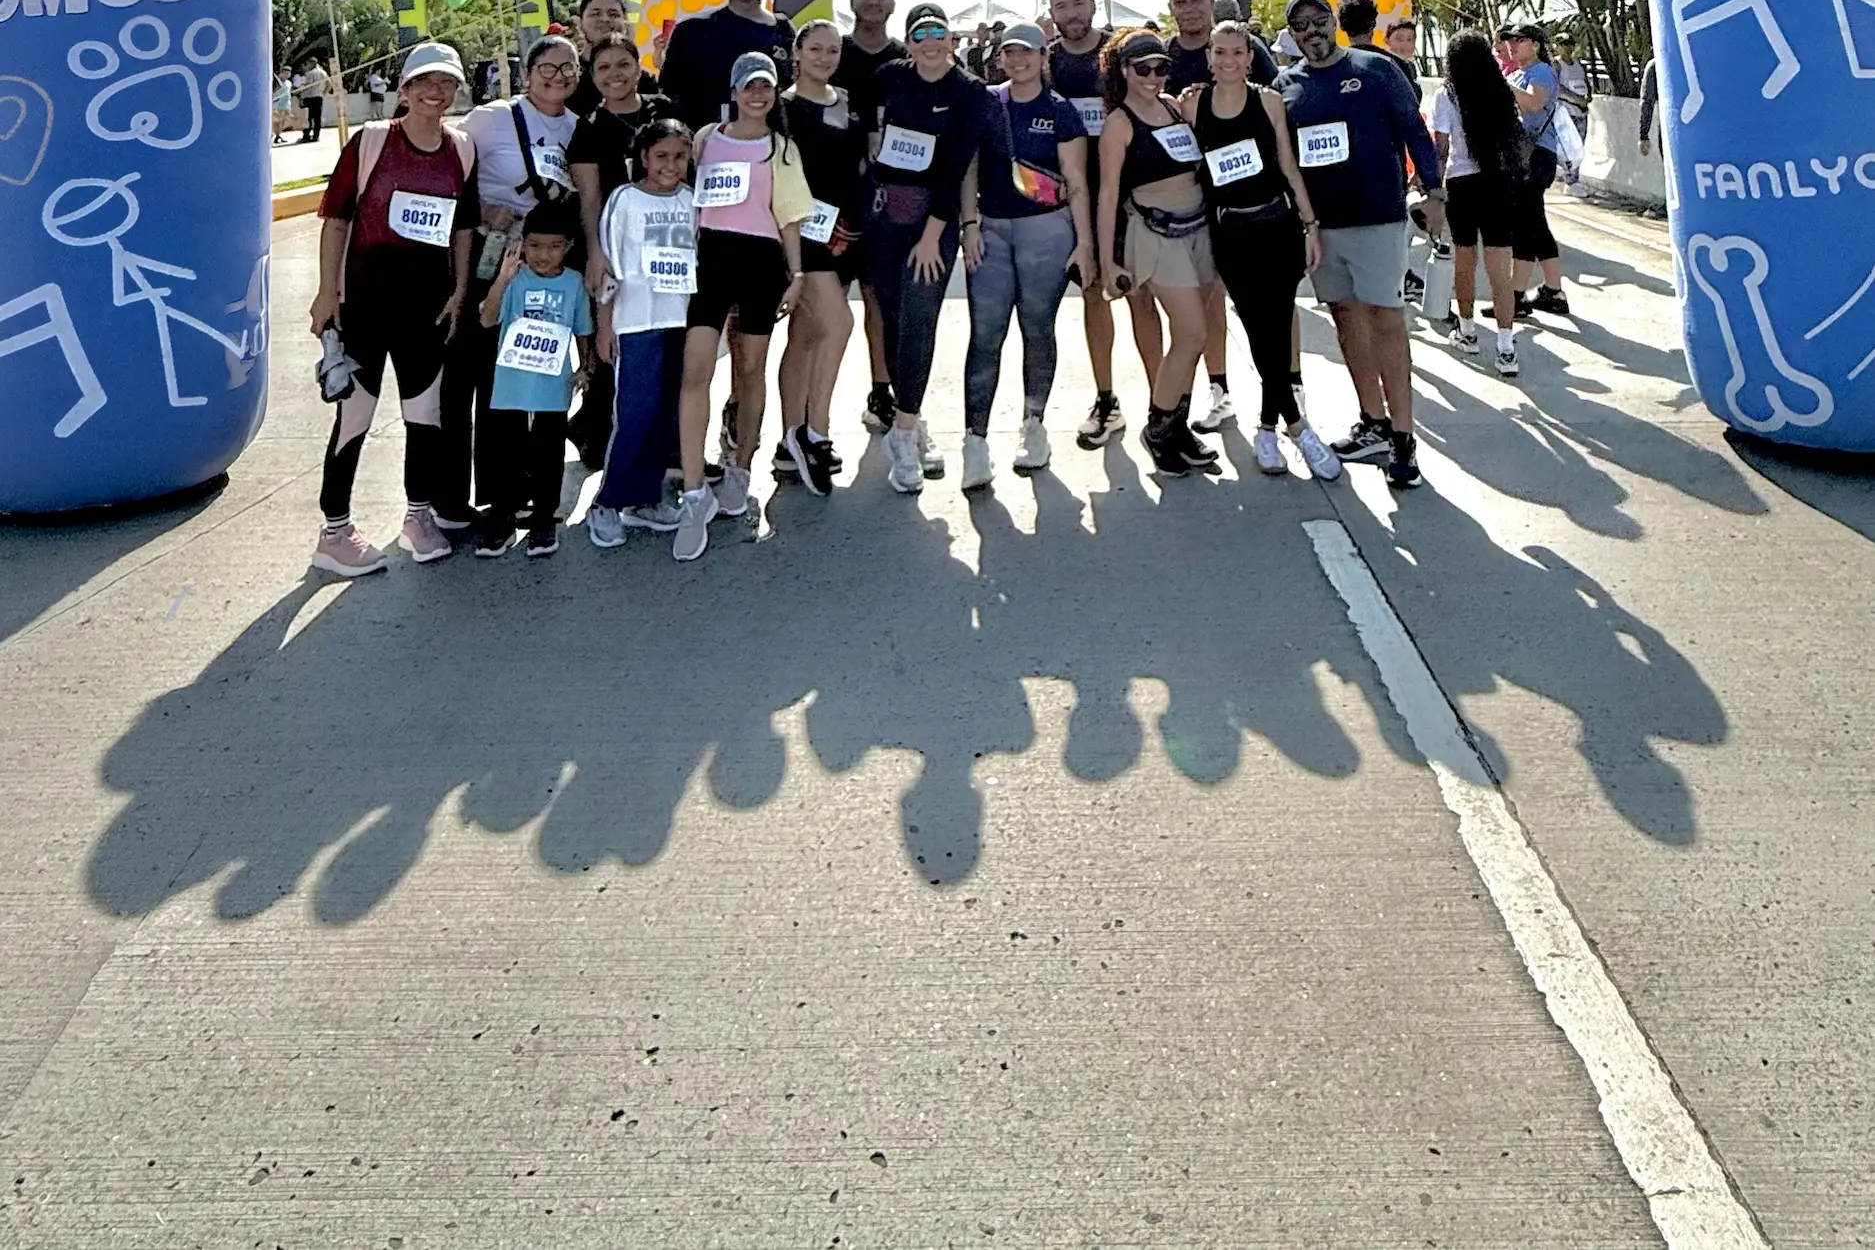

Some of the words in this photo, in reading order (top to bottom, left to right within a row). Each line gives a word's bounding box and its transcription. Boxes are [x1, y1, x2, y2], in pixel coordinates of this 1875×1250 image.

[891, 139, 926, 157] 80304
[1307, 135, 1340, 151] 80313
[1219, 153, 1253, 173] 80312
[703, 175, 741, 190] 80309
[402, 208, 442, 227] 80317
[643, 211, 691, 225] MONACO
[650, 261, 688, 276] 80306
[514, 333, 559, 354] 80308
